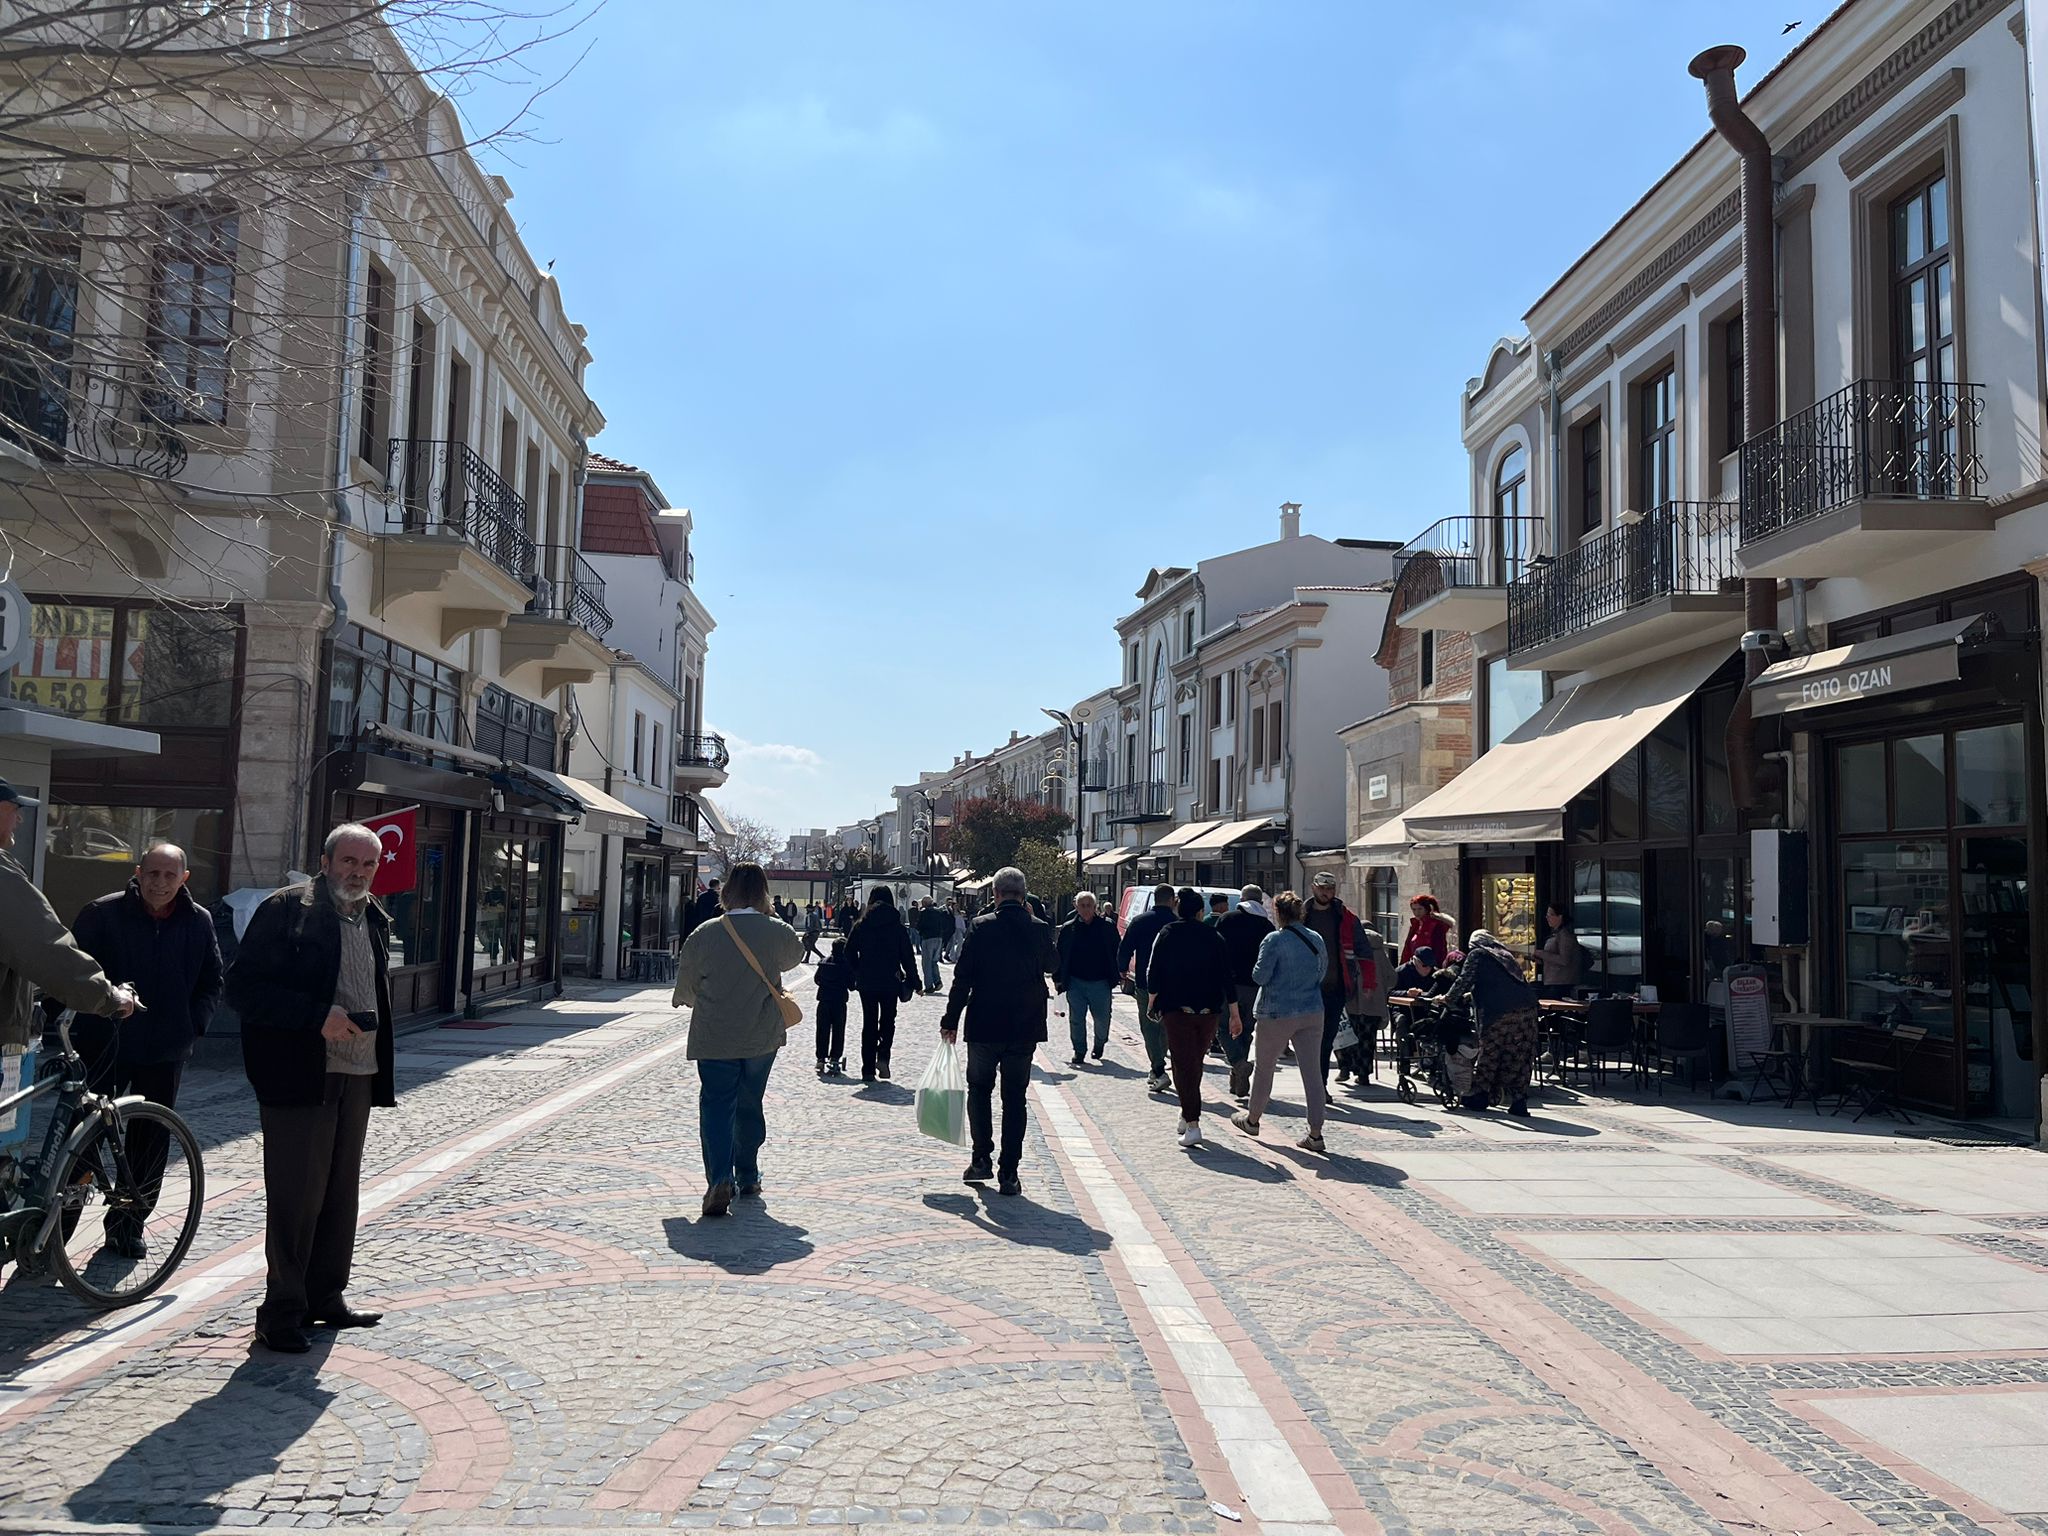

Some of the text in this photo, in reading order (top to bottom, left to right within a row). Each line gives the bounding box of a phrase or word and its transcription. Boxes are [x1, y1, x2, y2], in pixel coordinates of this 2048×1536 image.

[1802, 665, 1891, 703] FOTO OZAN
[40, 1120, 65, 1178] Bianchi
